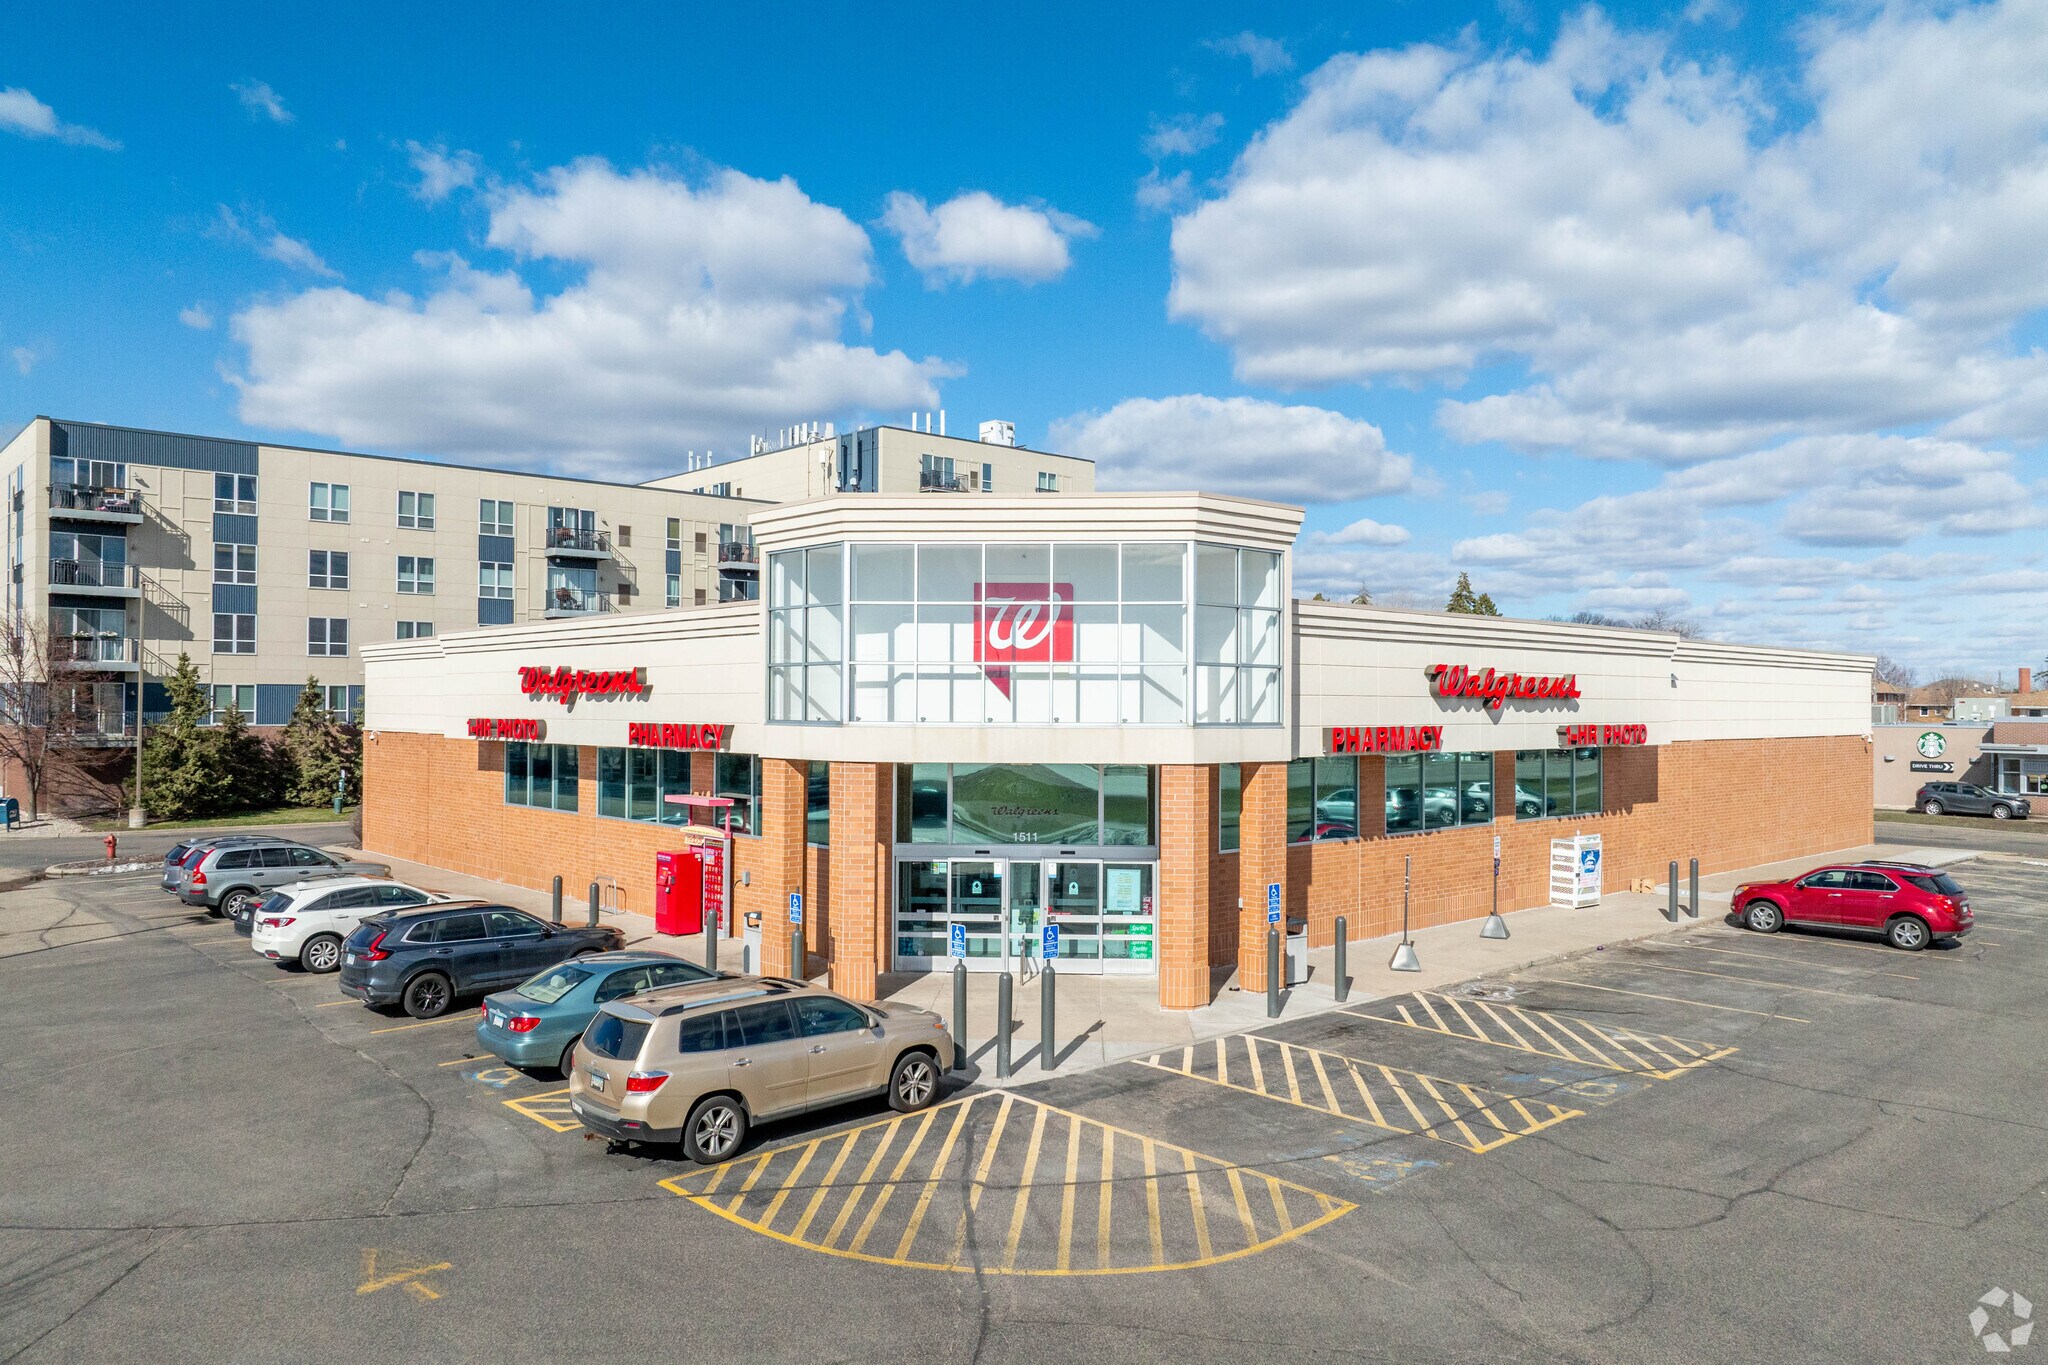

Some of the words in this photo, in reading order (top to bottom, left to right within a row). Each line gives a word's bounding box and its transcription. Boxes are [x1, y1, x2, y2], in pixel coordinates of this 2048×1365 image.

[517, 666, 645, 705] Walgreens
[1433, 664, 1581, 710] Walgreens
[467, 718, 491, 737] 1-HR
[497, 719, 539, 741] PHOTO
[628, 722, 726, 750] PHARMACY
[1332, 726, 1443, 752] PHARMACY
[1565, 725, 1597, 746] 1-HR
[1603, 723, 1647, 745] PHOTO
[991, 806, 1060, 818] Walgreens
[1012, 832, 1038, 842] 1511
